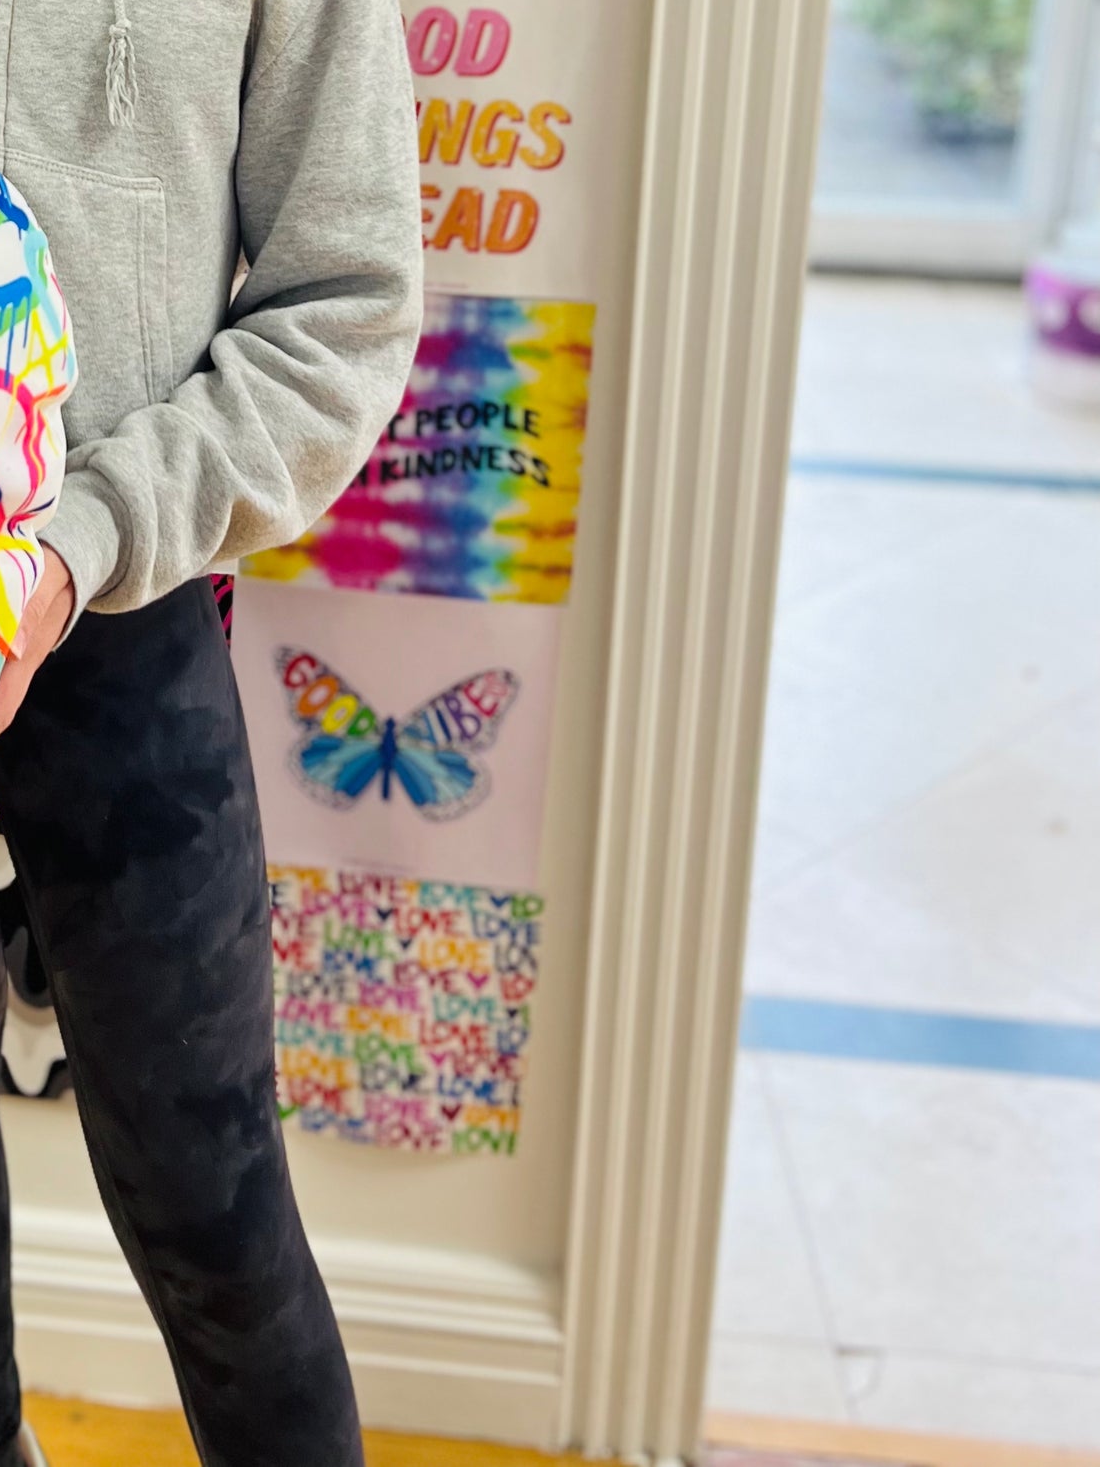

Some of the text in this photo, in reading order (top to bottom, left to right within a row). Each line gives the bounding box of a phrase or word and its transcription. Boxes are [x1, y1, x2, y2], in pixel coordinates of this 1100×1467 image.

[403, 6, 512, 77] OD
[416, 97, 572, 171] NGS
[415, 402, 541, 439] PEOPLE
[380, 445, 551, 488] KINDNESS
[283, 652, 377, 737] GOOD
[391, 906, 465, 936] LOVE
[419, 936, 491, 975] LOVE
[434, 994, 503, 1024] LOVE
